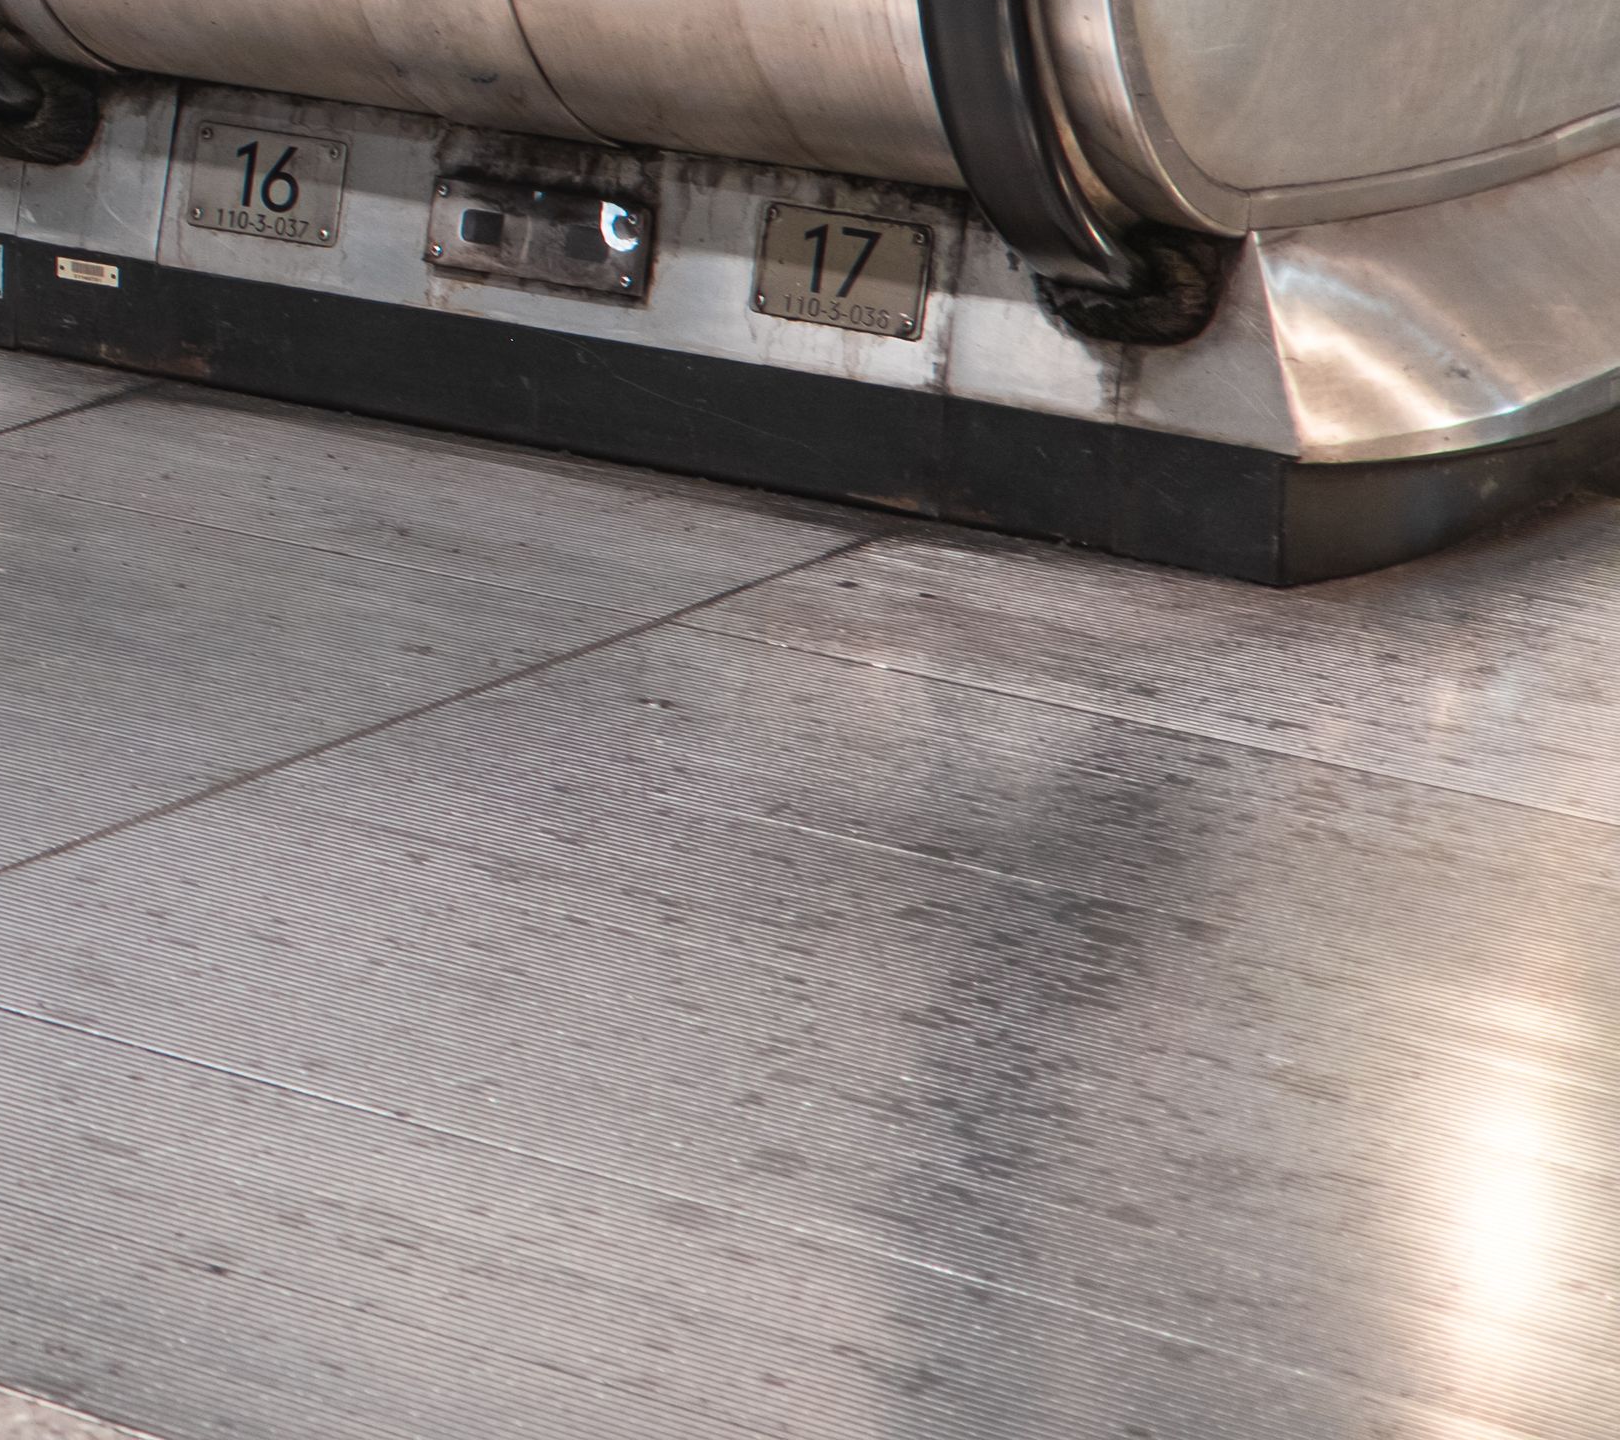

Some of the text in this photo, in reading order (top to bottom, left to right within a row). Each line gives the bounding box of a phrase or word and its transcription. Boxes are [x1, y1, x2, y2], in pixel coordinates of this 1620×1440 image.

[236, 140, 299, 213] 16
[217, 208, 310, 239] 110-3-037
[804, 223, 882, 298] 17
